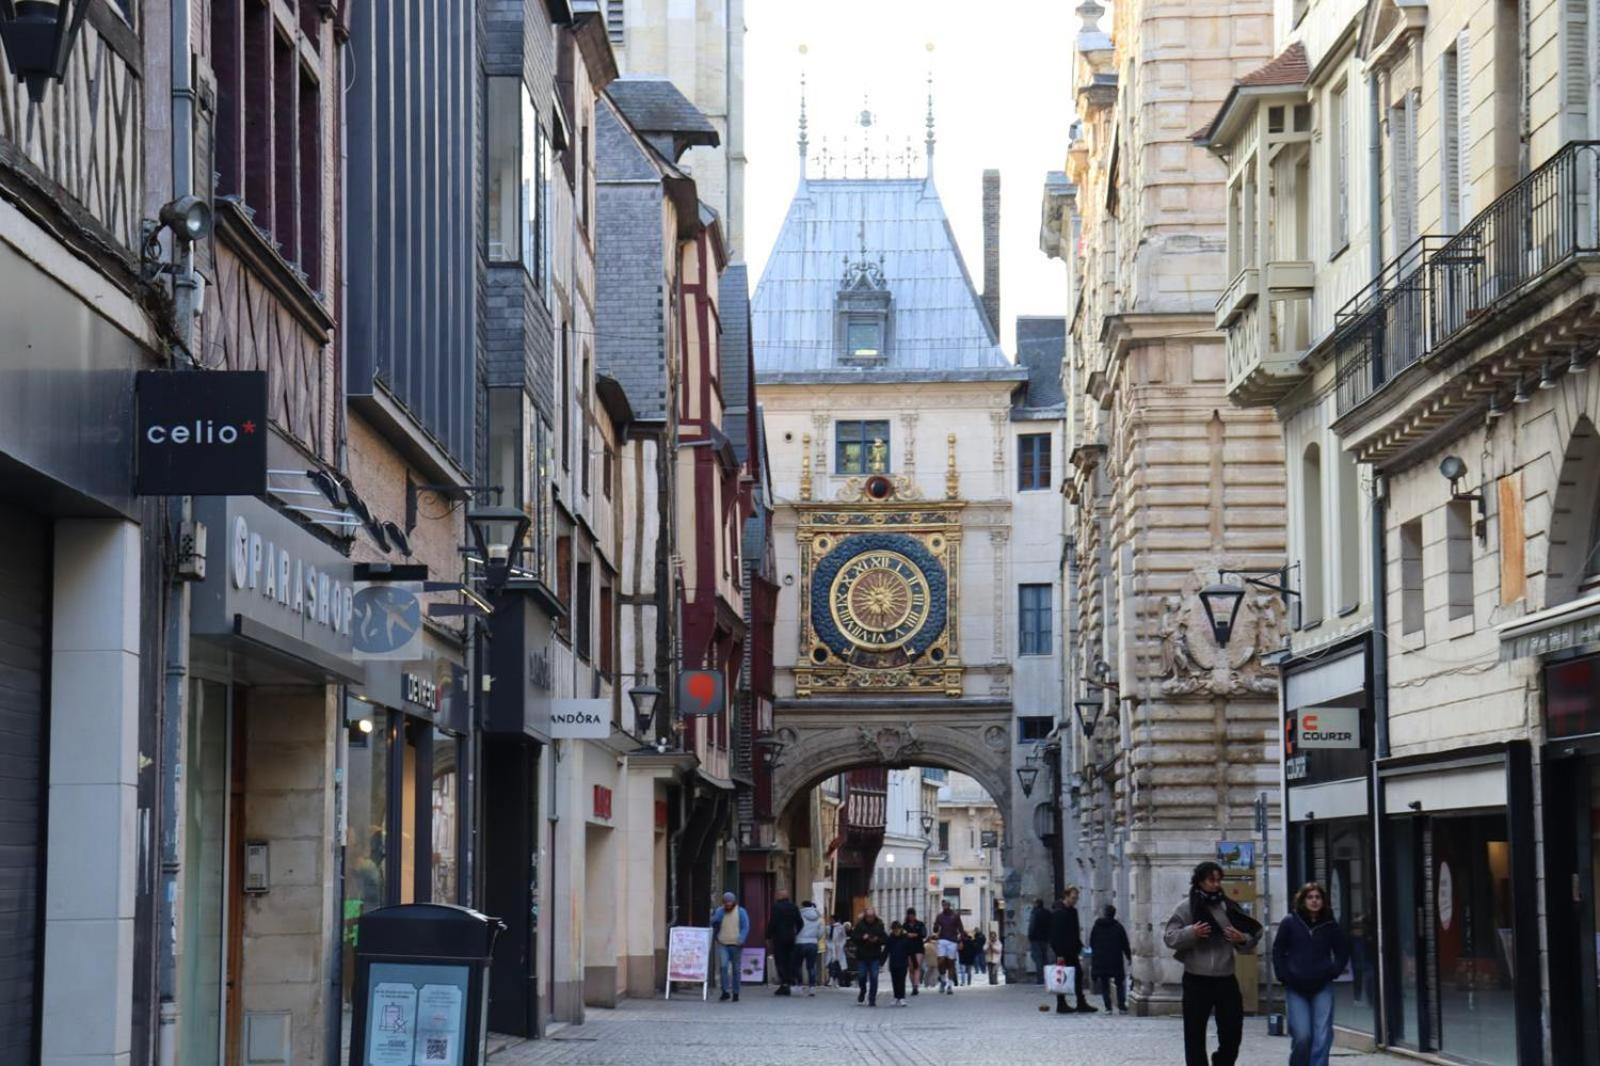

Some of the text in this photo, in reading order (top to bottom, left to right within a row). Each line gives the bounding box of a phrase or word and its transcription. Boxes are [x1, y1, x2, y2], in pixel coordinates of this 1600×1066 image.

[870, 557, 889, 567] XII
[248, 532, 353, 635] PARASHOP
[1302, 732, 1352, 741] COURIR
